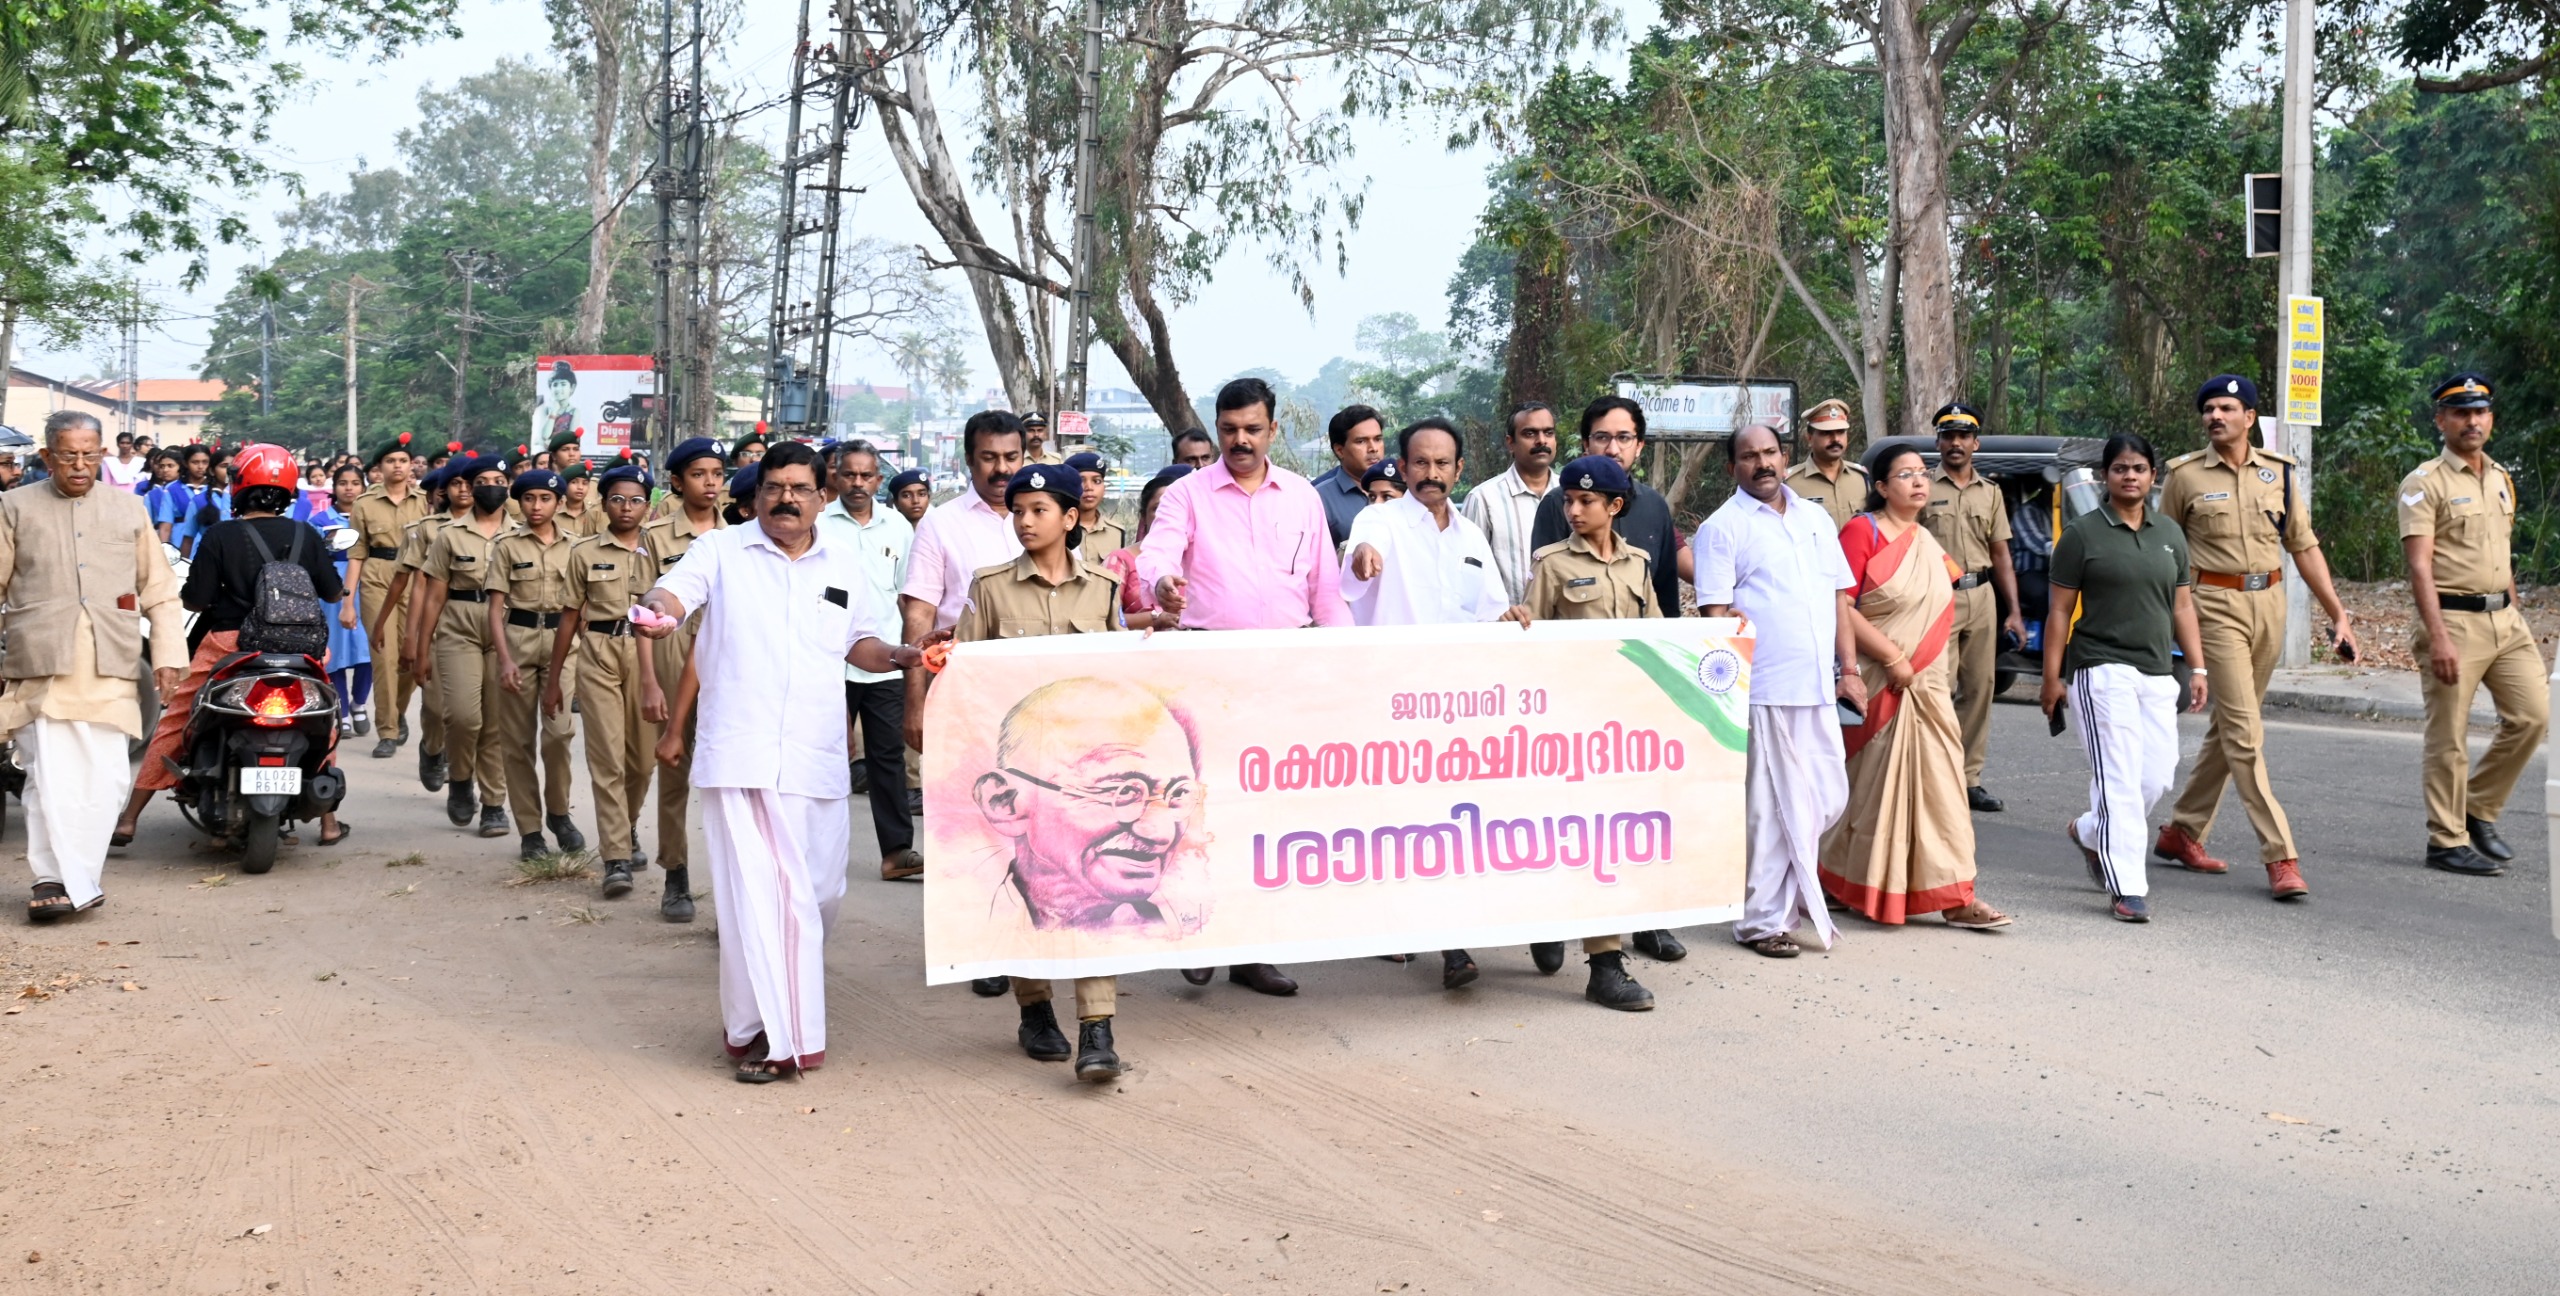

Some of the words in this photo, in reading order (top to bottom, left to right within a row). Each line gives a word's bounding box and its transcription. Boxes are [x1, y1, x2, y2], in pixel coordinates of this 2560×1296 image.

[2291, 375, 2318, 386] NOOR
[1628, 390, 1679, 412] Welcome
[1683, 394, 1695, 413] to
[600, 425, 625, 438] Diya
[1391, 683, 1505, 725] ജനുവരി
[1518, 688, 1547, 715] 30
[1238, 720, 1685, 793] രക്തസാക്ഷിത്വദിനം
[256, 770, 296, 781] KL02B
[255, 781, 295, 793] R6142
[1253, 801, 1674, 889] ശാന്തിയാത്ര
